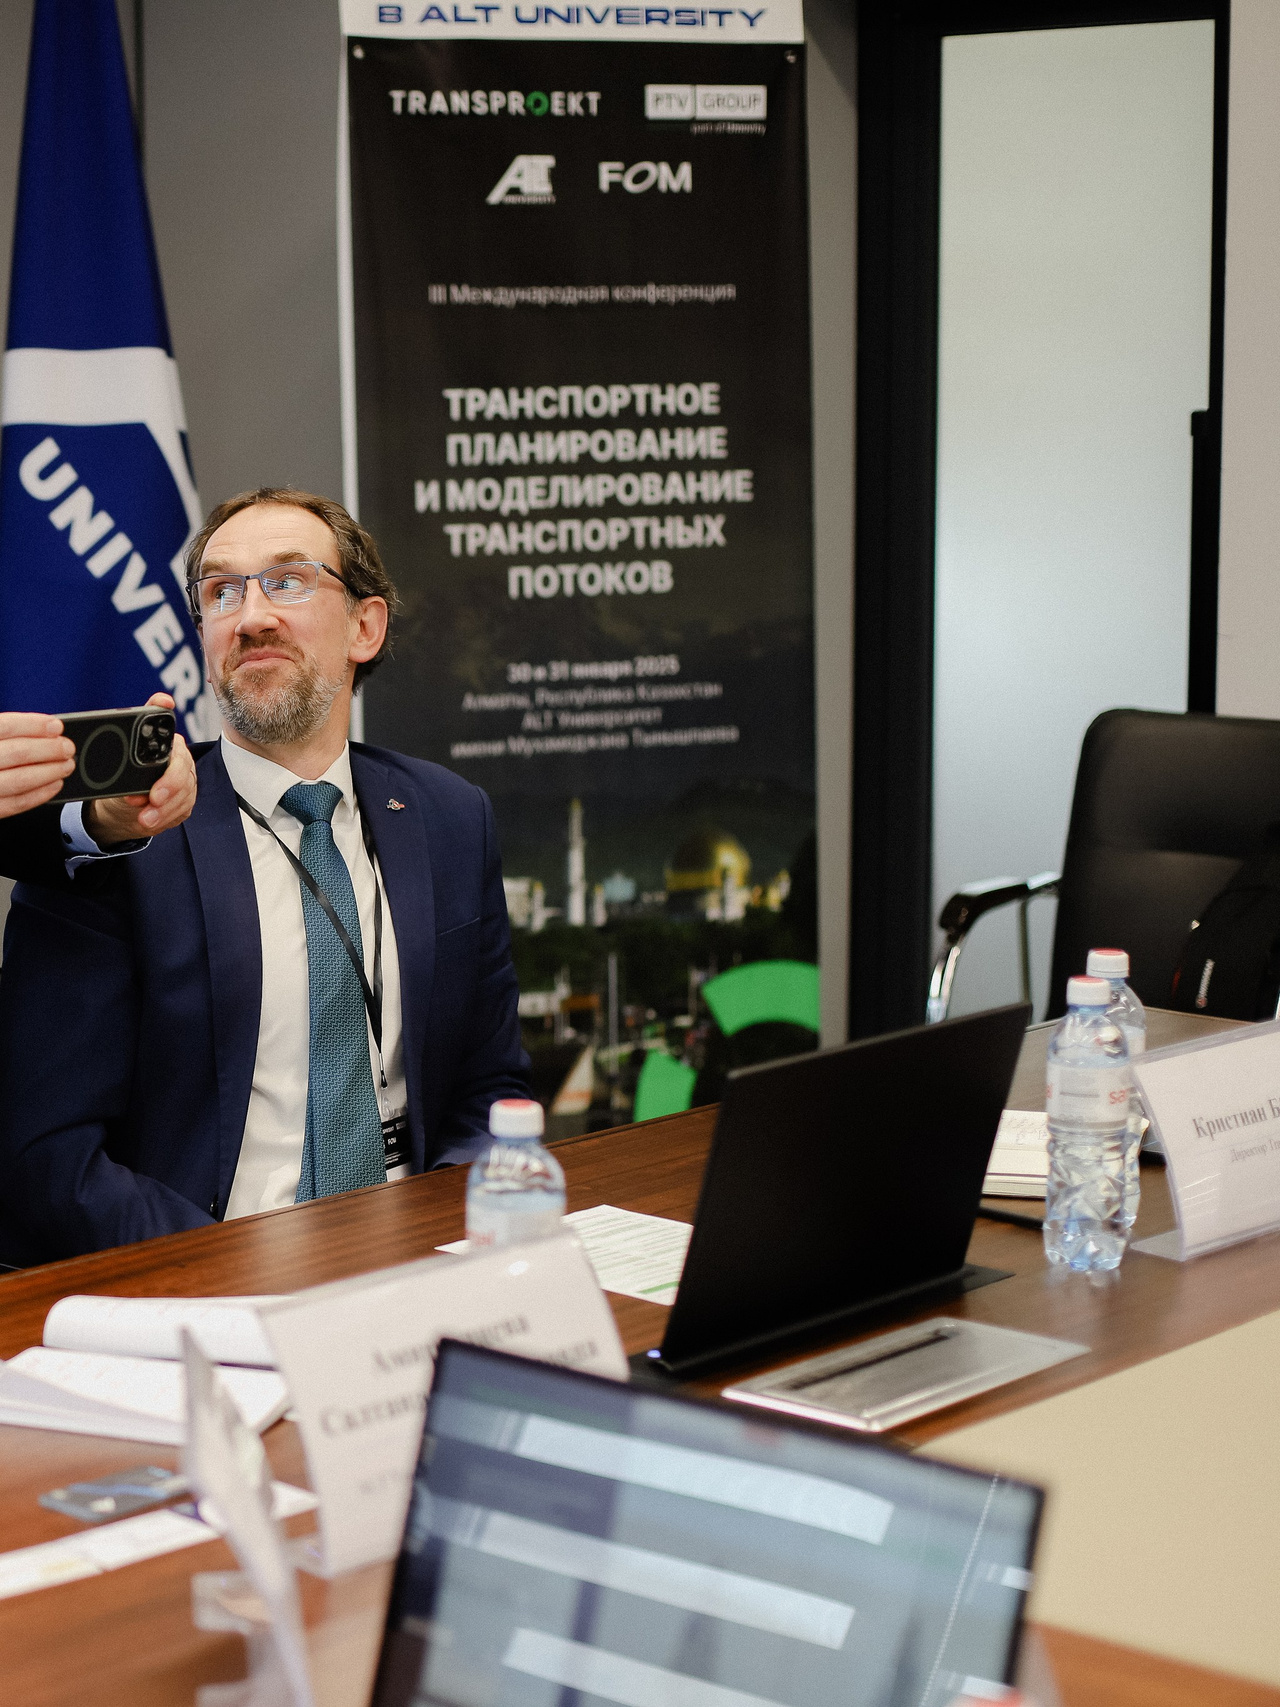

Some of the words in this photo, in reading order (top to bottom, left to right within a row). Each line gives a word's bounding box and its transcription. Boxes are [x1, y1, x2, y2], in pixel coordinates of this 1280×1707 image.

[421, 6, 500, 24] ALT
[515, 7, 766, 27] UNIVERSITY
[389, 90, 601, 116] TRANSPROEKT
[598, 161, 693, 194] FOM
[443, 382, 721, 421] ТРАНСПОРТНОЕ
[446, 426, 728, 467] ПЛАНИРОВАНИЕ
[414, 479, 441, 514] И
[445, 469, 754, 516] МОДЕЛИРОВАНИЕ
[443, 514, 726, 557] ТРАНСПОРТНЫХ
[508, 560, 674, 599] ПОТОКОВ
[1192, 1107, 1268, 1141] Кристиан
